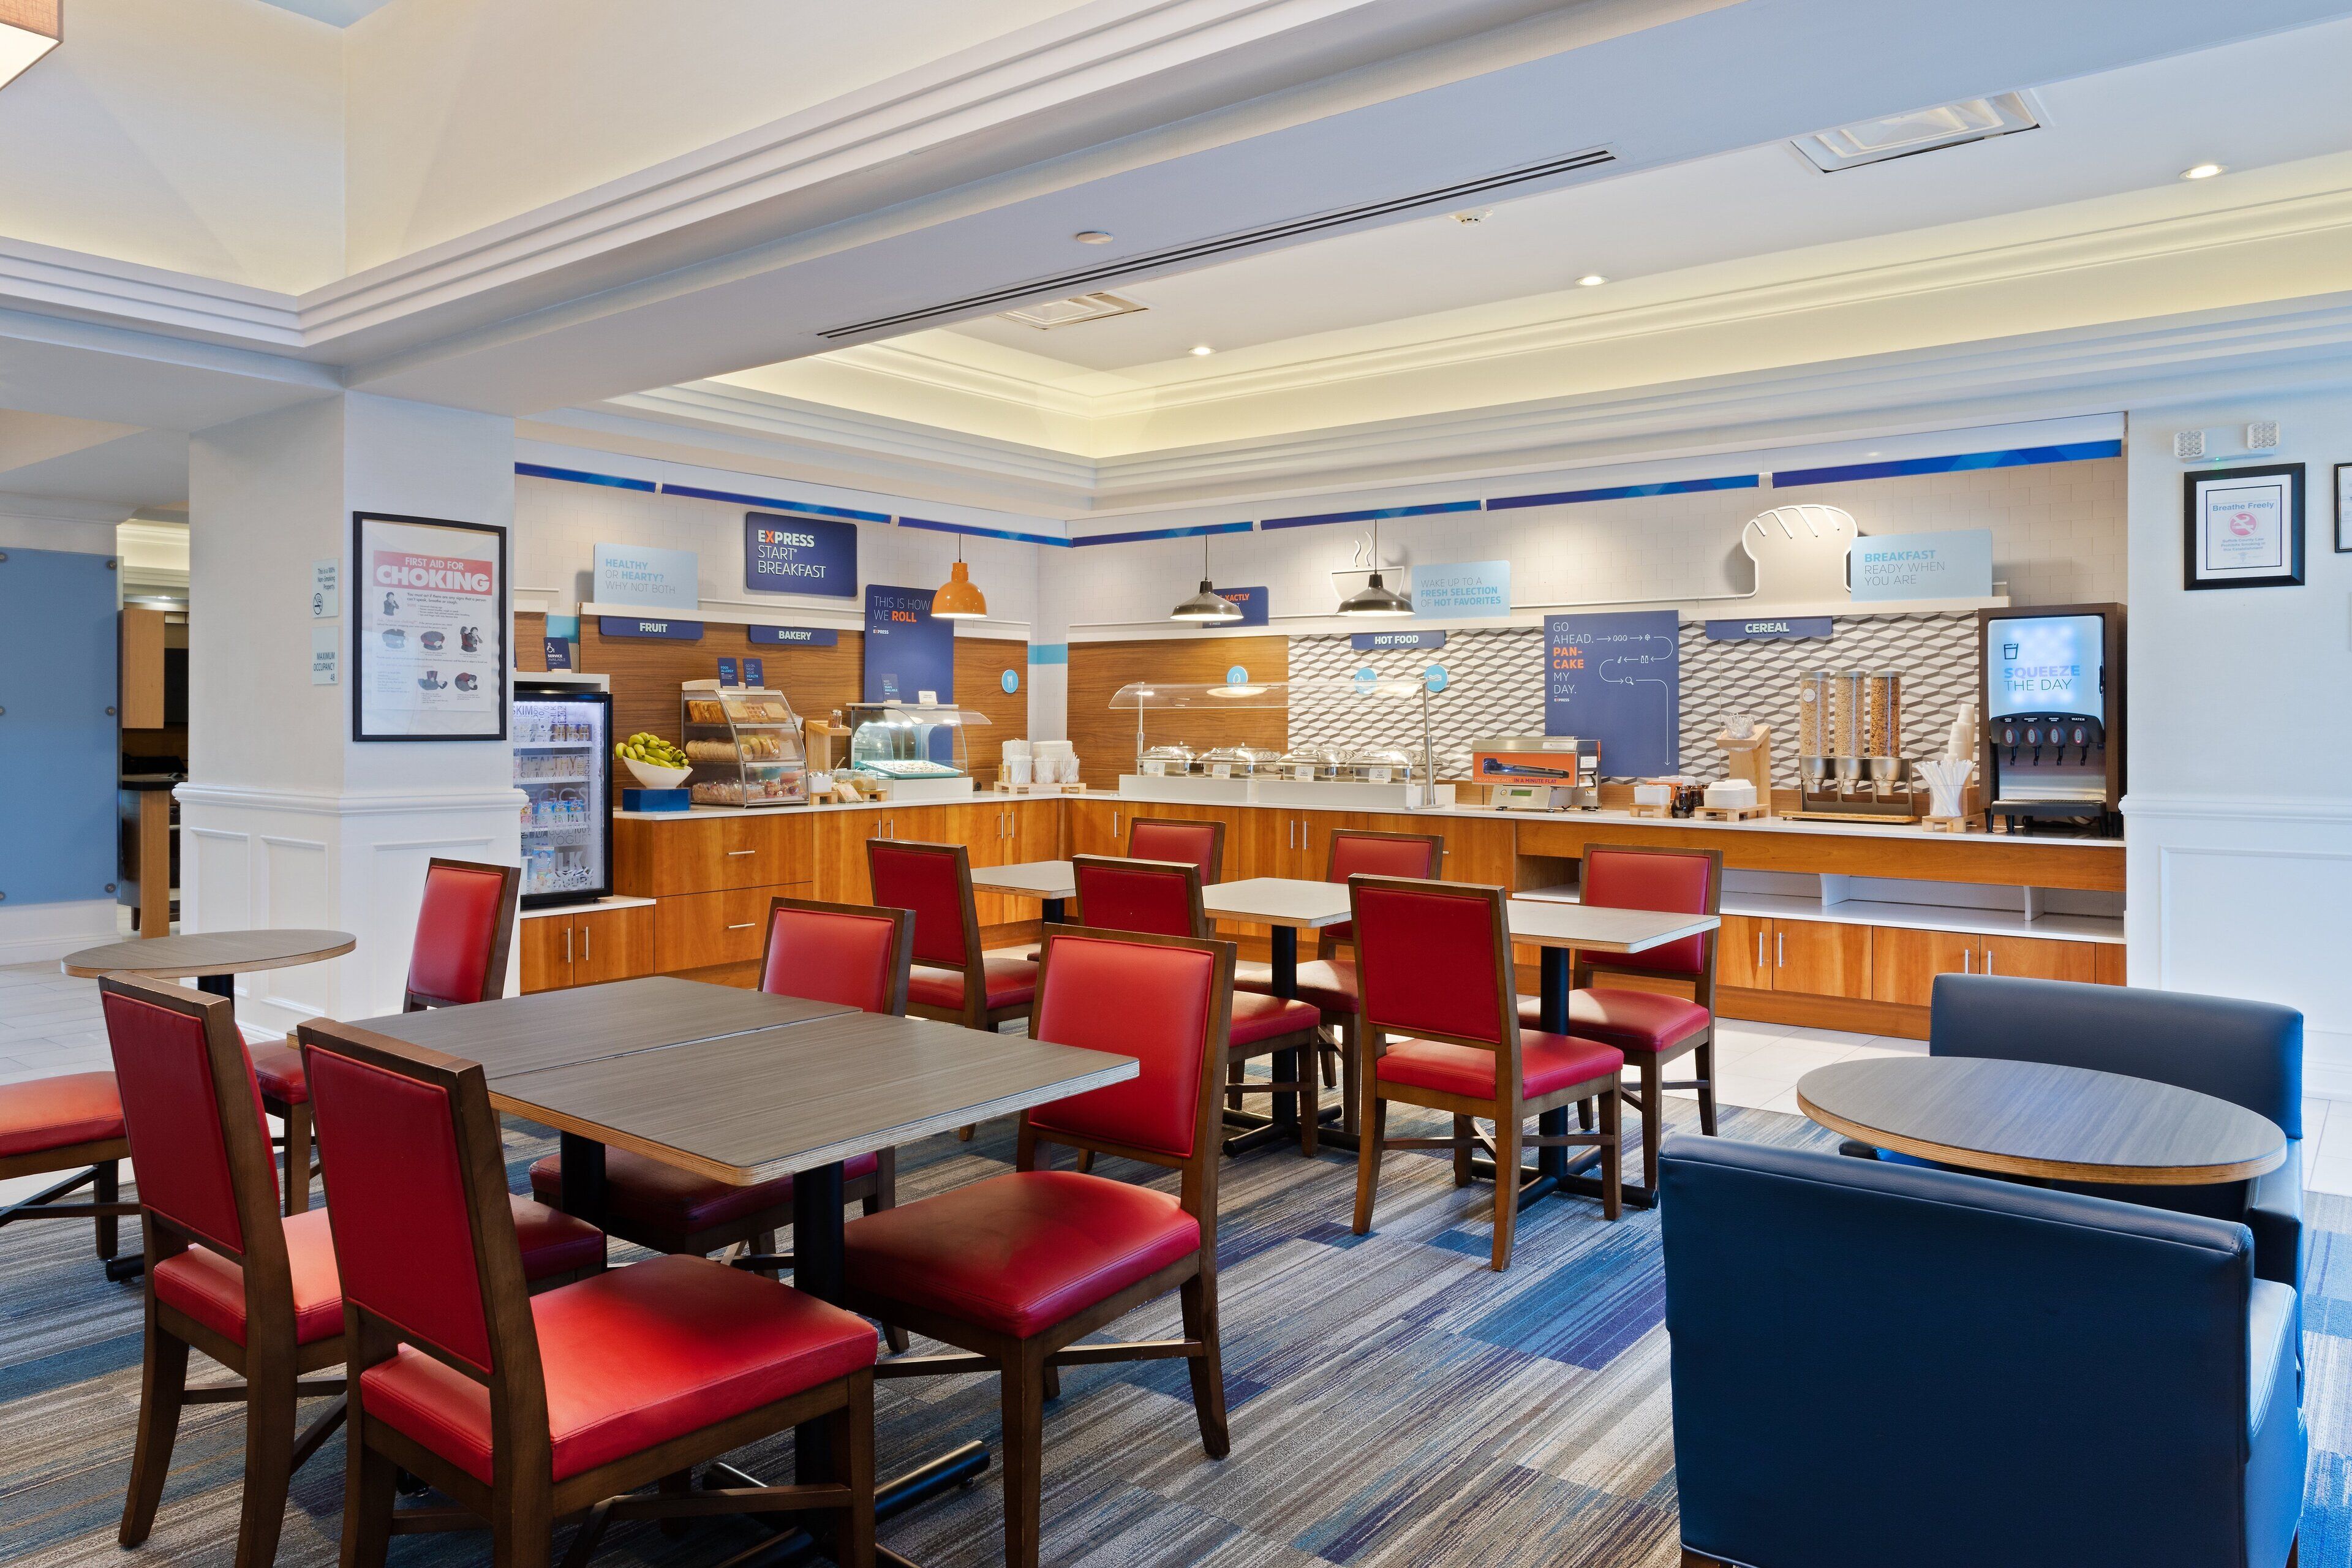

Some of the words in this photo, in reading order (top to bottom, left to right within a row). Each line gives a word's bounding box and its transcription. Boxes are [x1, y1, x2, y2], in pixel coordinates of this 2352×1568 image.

[758, 529, 815, 548] EXPRESS
[1864, 550, 1936, 562] BREAKFAST
[405, 557, 427, 567] FIRST
[429, 560, 445, 568] AID
[447, 561, 464, 570] FOR
[605, 558, 648, 570] HEALTHY
[758, 560, 826, 578] BREAKFAST
[1864, 563, 1904, 575] READY
[1908, 561, 1945, 571] WHEN
[376, 565, 490, 592] CHOKING
[605, 569, 619, 579] OR
[621, 571, 664, 582] HEARTY?
[1864, 576, 1889, 586] YOU
[1894, 575, 1916, 584] ARE
[1421, 579, 1445, 587] WAKE
[1448, 578, 1460, 587] UP
[1462, 577, 1473, 586] TO
[1476, 576, 1482, 585] A
[605, 581, 628, 590] WHY
[631, 582, 649, 592] NOT
[652, 584, 676, 594] BOTH
[1421, 589, 1448, 597] FRESH
[1450, 586, 1498, 596] SELECTION
[874, 596, 894, 608] THIS
[897, 598, 905, 609] IS
[908, 599, 930, 611] HOW
[1421, 599, 1431, 608] OF
[1434, 598, 1451, 606] HOT
[1454, 596, 1501, 606] FAVORITES
[873, 609, 889, 621] WE
[892, 610, 917, 623] ROLL
[639, 622, 668, 633] FRUIT
[1553, 622, 1569, 632] GO
[1745, 622, 1790, 633] CEREAL
[778, 630, 812, 641] BAKERY
[1374, 636, 1392, 644] HOT
[1395, 635, 1419, 644] FOOD
[1553, 634, 1594, 644] AHEAD.
[1553, 647, 1583, 657] PAN-
[314, 662, 335, 671] OCCUPANCY
[1553, 659, 1584, 669] CAKE
[1554, 672, 1569, 682] MY
[2004, 665, 2080, 679] SQUEEZE
[1554, 684, 1577, 694] DAY.
[2004, 680, 2034, 691] THE
[2041, 679, 2071, 690] DAY
